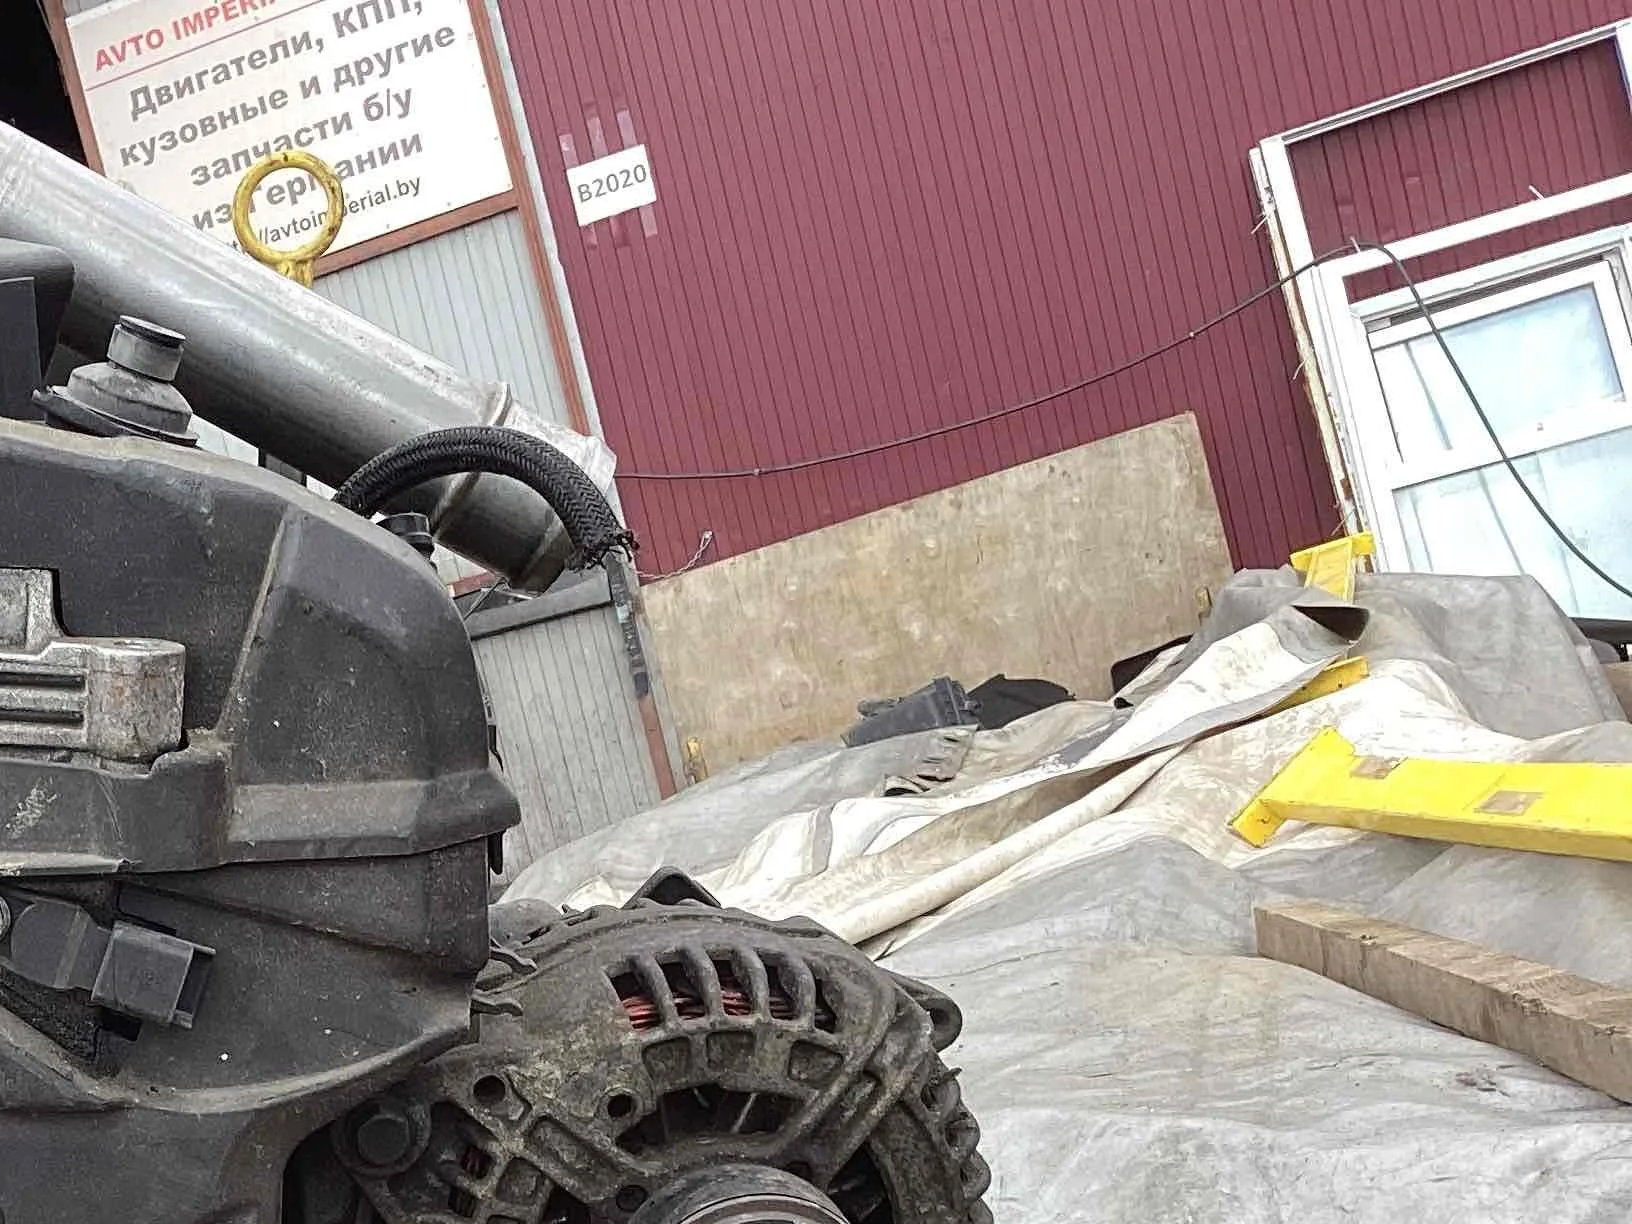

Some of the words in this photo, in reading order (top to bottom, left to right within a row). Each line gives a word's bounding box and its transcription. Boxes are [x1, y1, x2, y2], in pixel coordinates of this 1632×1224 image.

[95, 29, 165, 71] AVTO
[172, 0, 275, 40] IMPER
[120, 89, 288, 167] кузовные
[299, 75, 321, 100] и
[333, 24, 456, 92] другие
[129, 31, 324, 122] Двигатели,
[190, 112, 352, 186] запчасти
[363, 88, 412, 122] б/у
[192, 203, 233, 231] из
[577, 163, 647, 203] B2020
